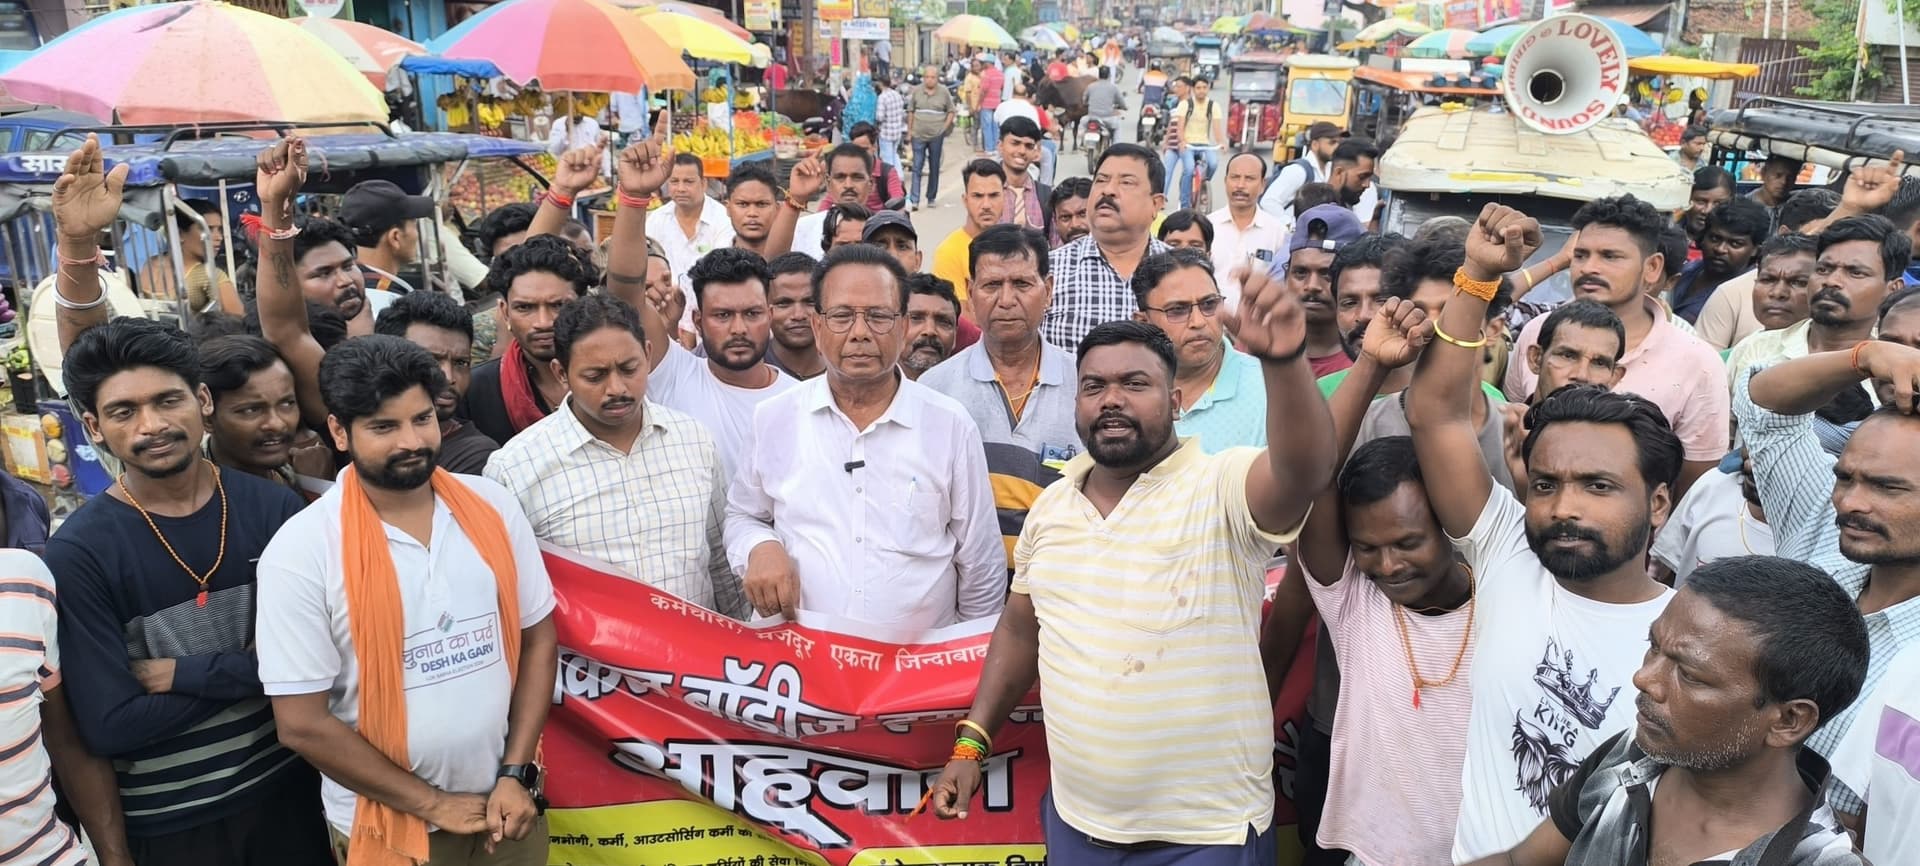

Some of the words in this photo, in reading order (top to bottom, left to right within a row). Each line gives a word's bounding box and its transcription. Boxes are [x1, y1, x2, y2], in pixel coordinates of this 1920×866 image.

[1557, 19, 1620, 94] LOVELY
[1521, 98, 1606, 130] SOUND
[402, 638, 445, 671] चुनाव
[446, 631, 470, 650] का
[471, 618, 494, 642] पर्व
[420, 656, 450, 674] DESH
[451, 651, 468, 665] KA
[467, 641, 495, 660] GARV
[830, 643, 884, 673] एकता
[1534, 703, 1577, 748] KING
[708, 825, 735, 838] कर्मी
[768, 854, 791, 866] सेवा
